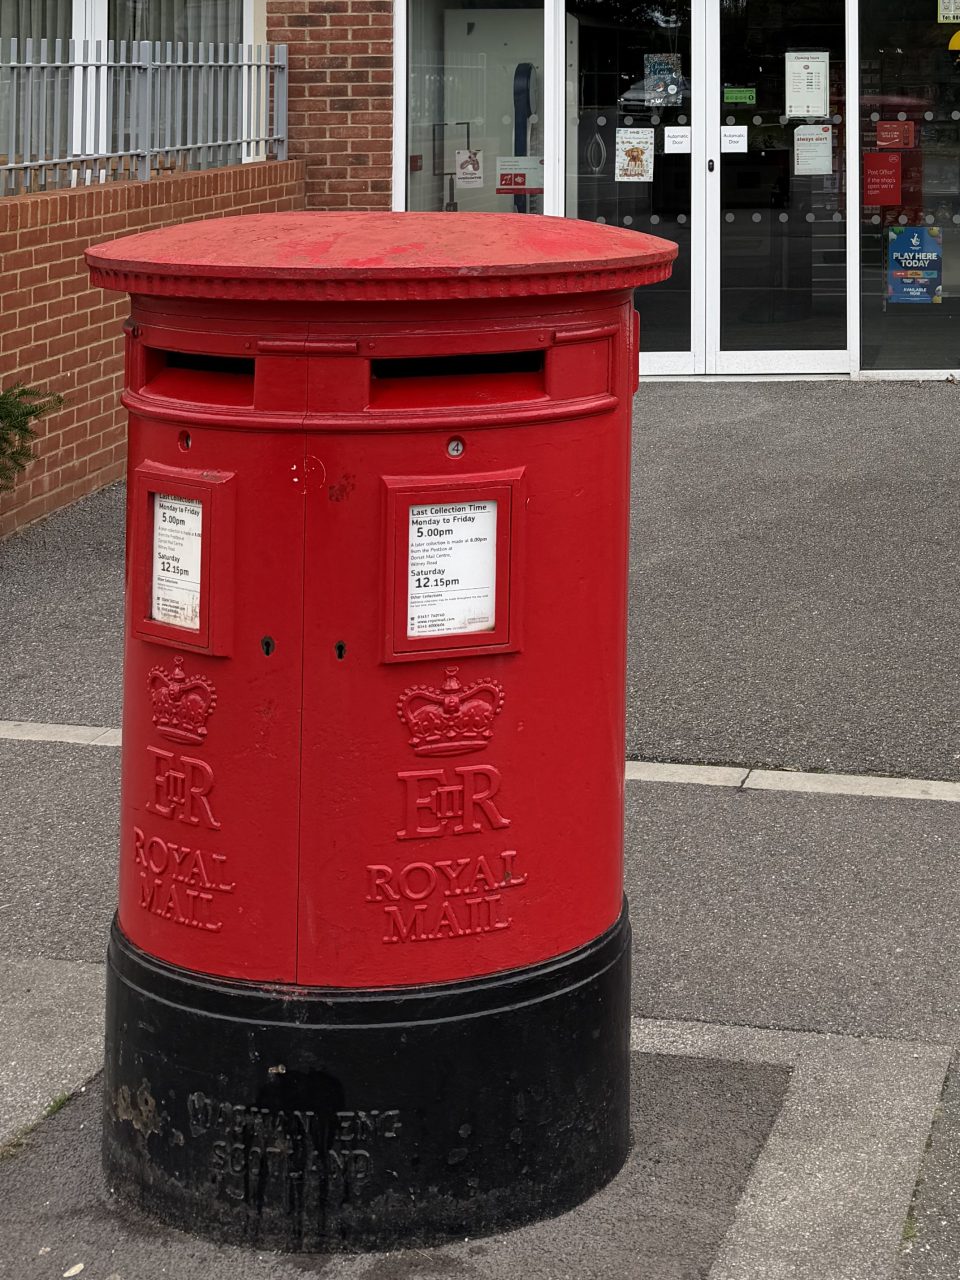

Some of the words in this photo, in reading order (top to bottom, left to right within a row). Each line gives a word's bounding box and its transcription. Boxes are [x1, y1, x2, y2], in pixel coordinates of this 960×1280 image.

[452, 441, 461, 453] 4
[159, 503, 178, 513] Monday
[184, 507, 200, 517] Friday
[430, 505, 466, 515] Collection
[468, 504, 487, 512] Time
[162, 512, 186, 526] 5.00pm
[411, 518, 440, 526] Monday
[453, 515, 476, 524] Friday
[417, 527, 453, 538] 5.00pm
[158, 552, 180, 563] Saturday
[161, 561, 189, 576] 12.15pm
[411, 568, 446, 577] Saturday
[415, 577, 460, 588] 12.15pm
[133, 826, 236, 892] ROYAL
[365, 850, 528, 903] ROYAL
[138, 872, 224, 932] MAIL
[382, 894, 513, 944] MAIL
